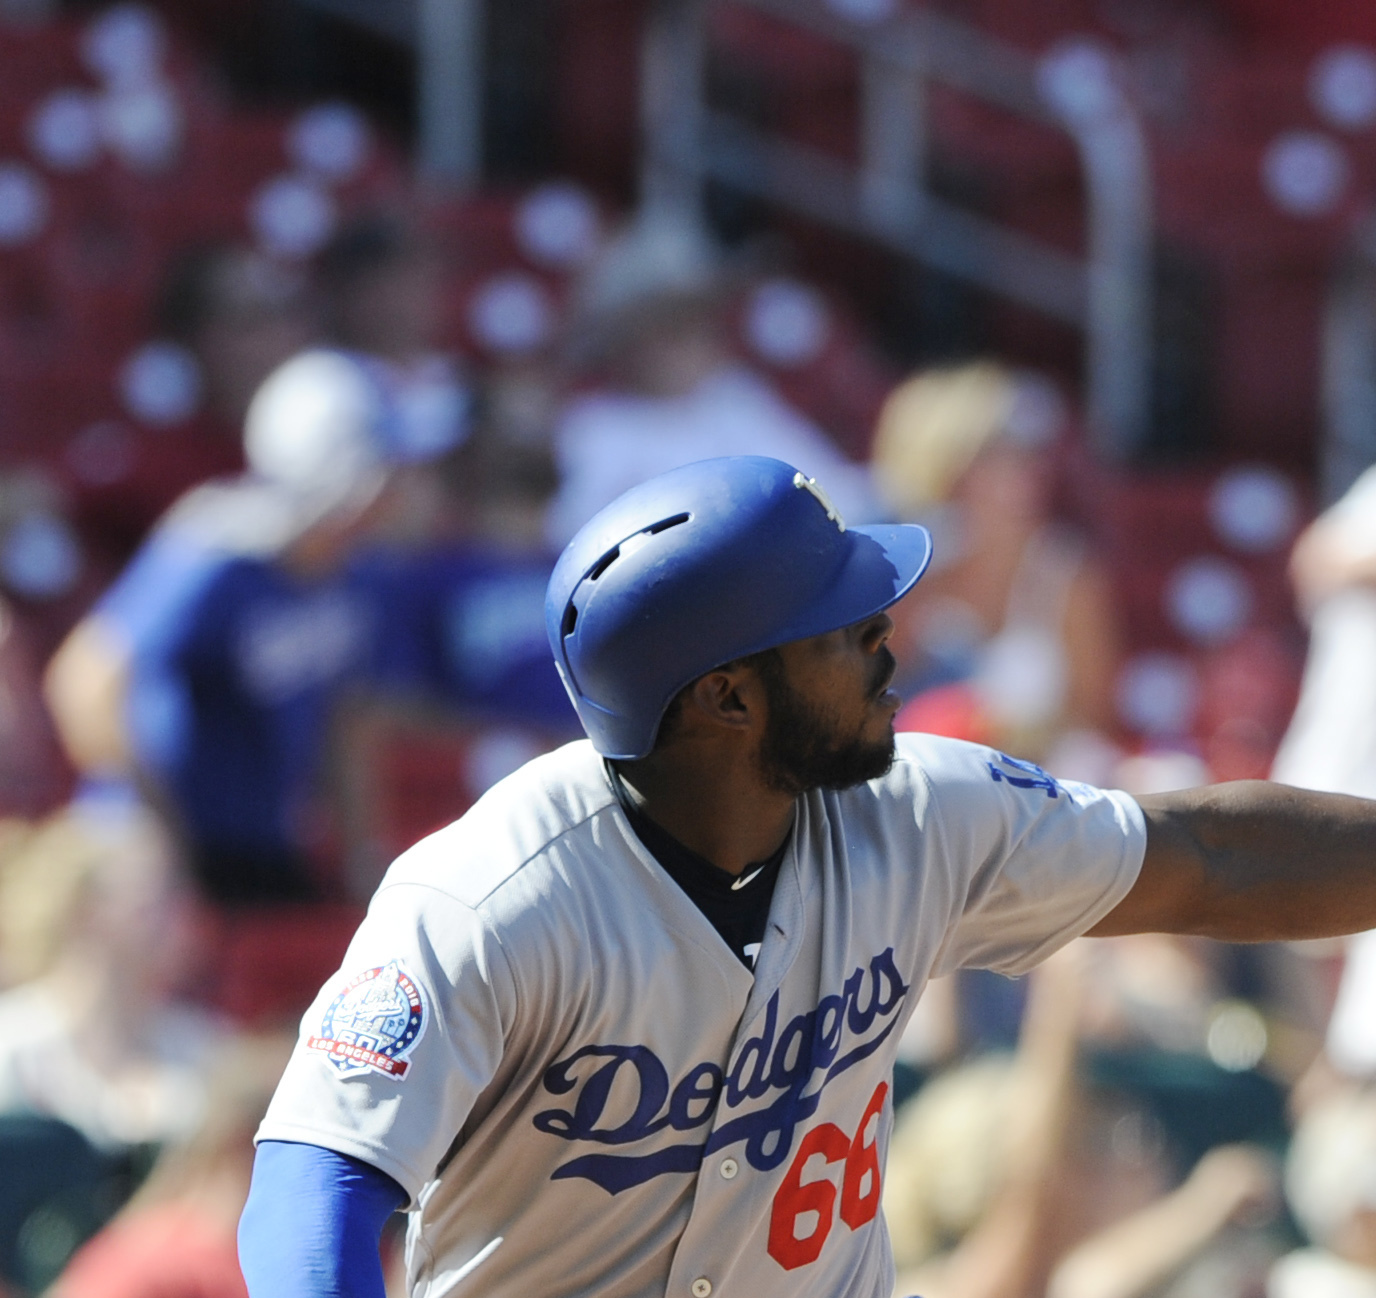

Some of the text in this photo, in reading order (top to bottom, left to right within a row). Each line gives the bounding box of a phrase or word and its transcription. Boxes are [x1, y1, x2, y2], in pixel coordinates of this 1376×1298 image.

[312, 1039, 395, 1072] LOS ANGELES
[533, 947, 911, 1172] Dodgers
[767, 1081, 888, 1271] 66
